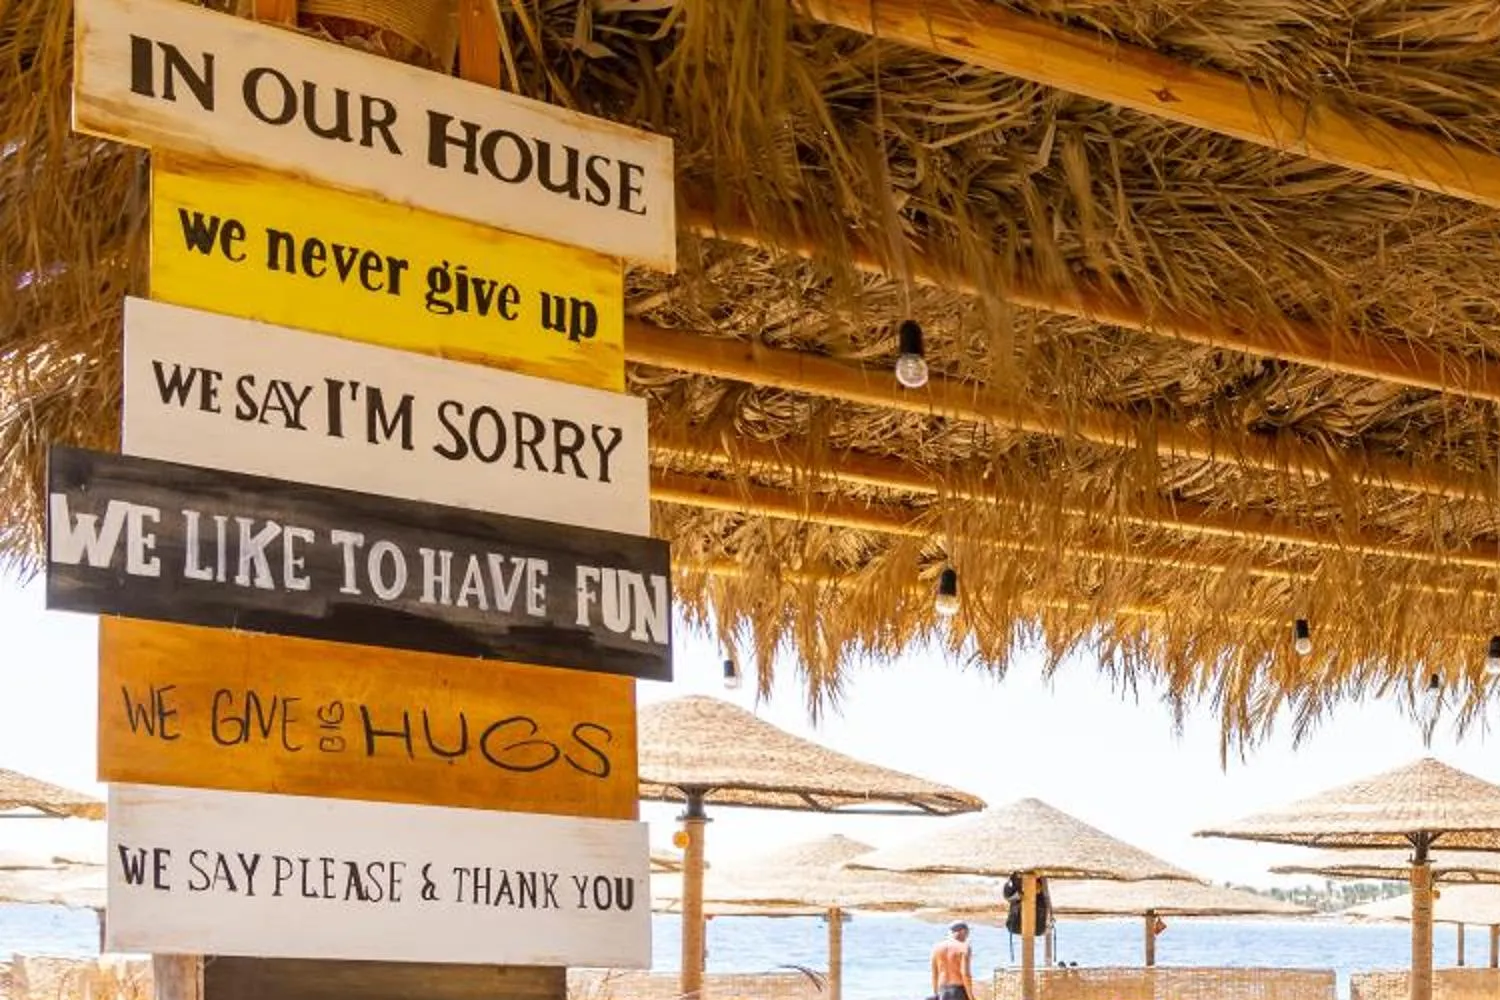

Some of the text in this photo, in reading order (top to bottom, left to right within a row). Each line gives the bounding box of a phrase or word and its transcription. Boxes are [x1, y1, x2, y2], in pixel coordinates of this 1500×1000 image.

[129, 34, 647, 216] IN OUR HOUSE
[178, 207, 598, 342] we never give up
[153, 360, 623, 483] WE SAY I'M SORRY
[49, 493, 669, 645] WE LIKE TO HAVE FUN
[123, 684, 180, 740] WE
[319, 700, 344, 752] BIG
[359, 705, 612, 779] HUGS
[118, 844, 634, 912] WE SAY PLEASE & THANK YOU
